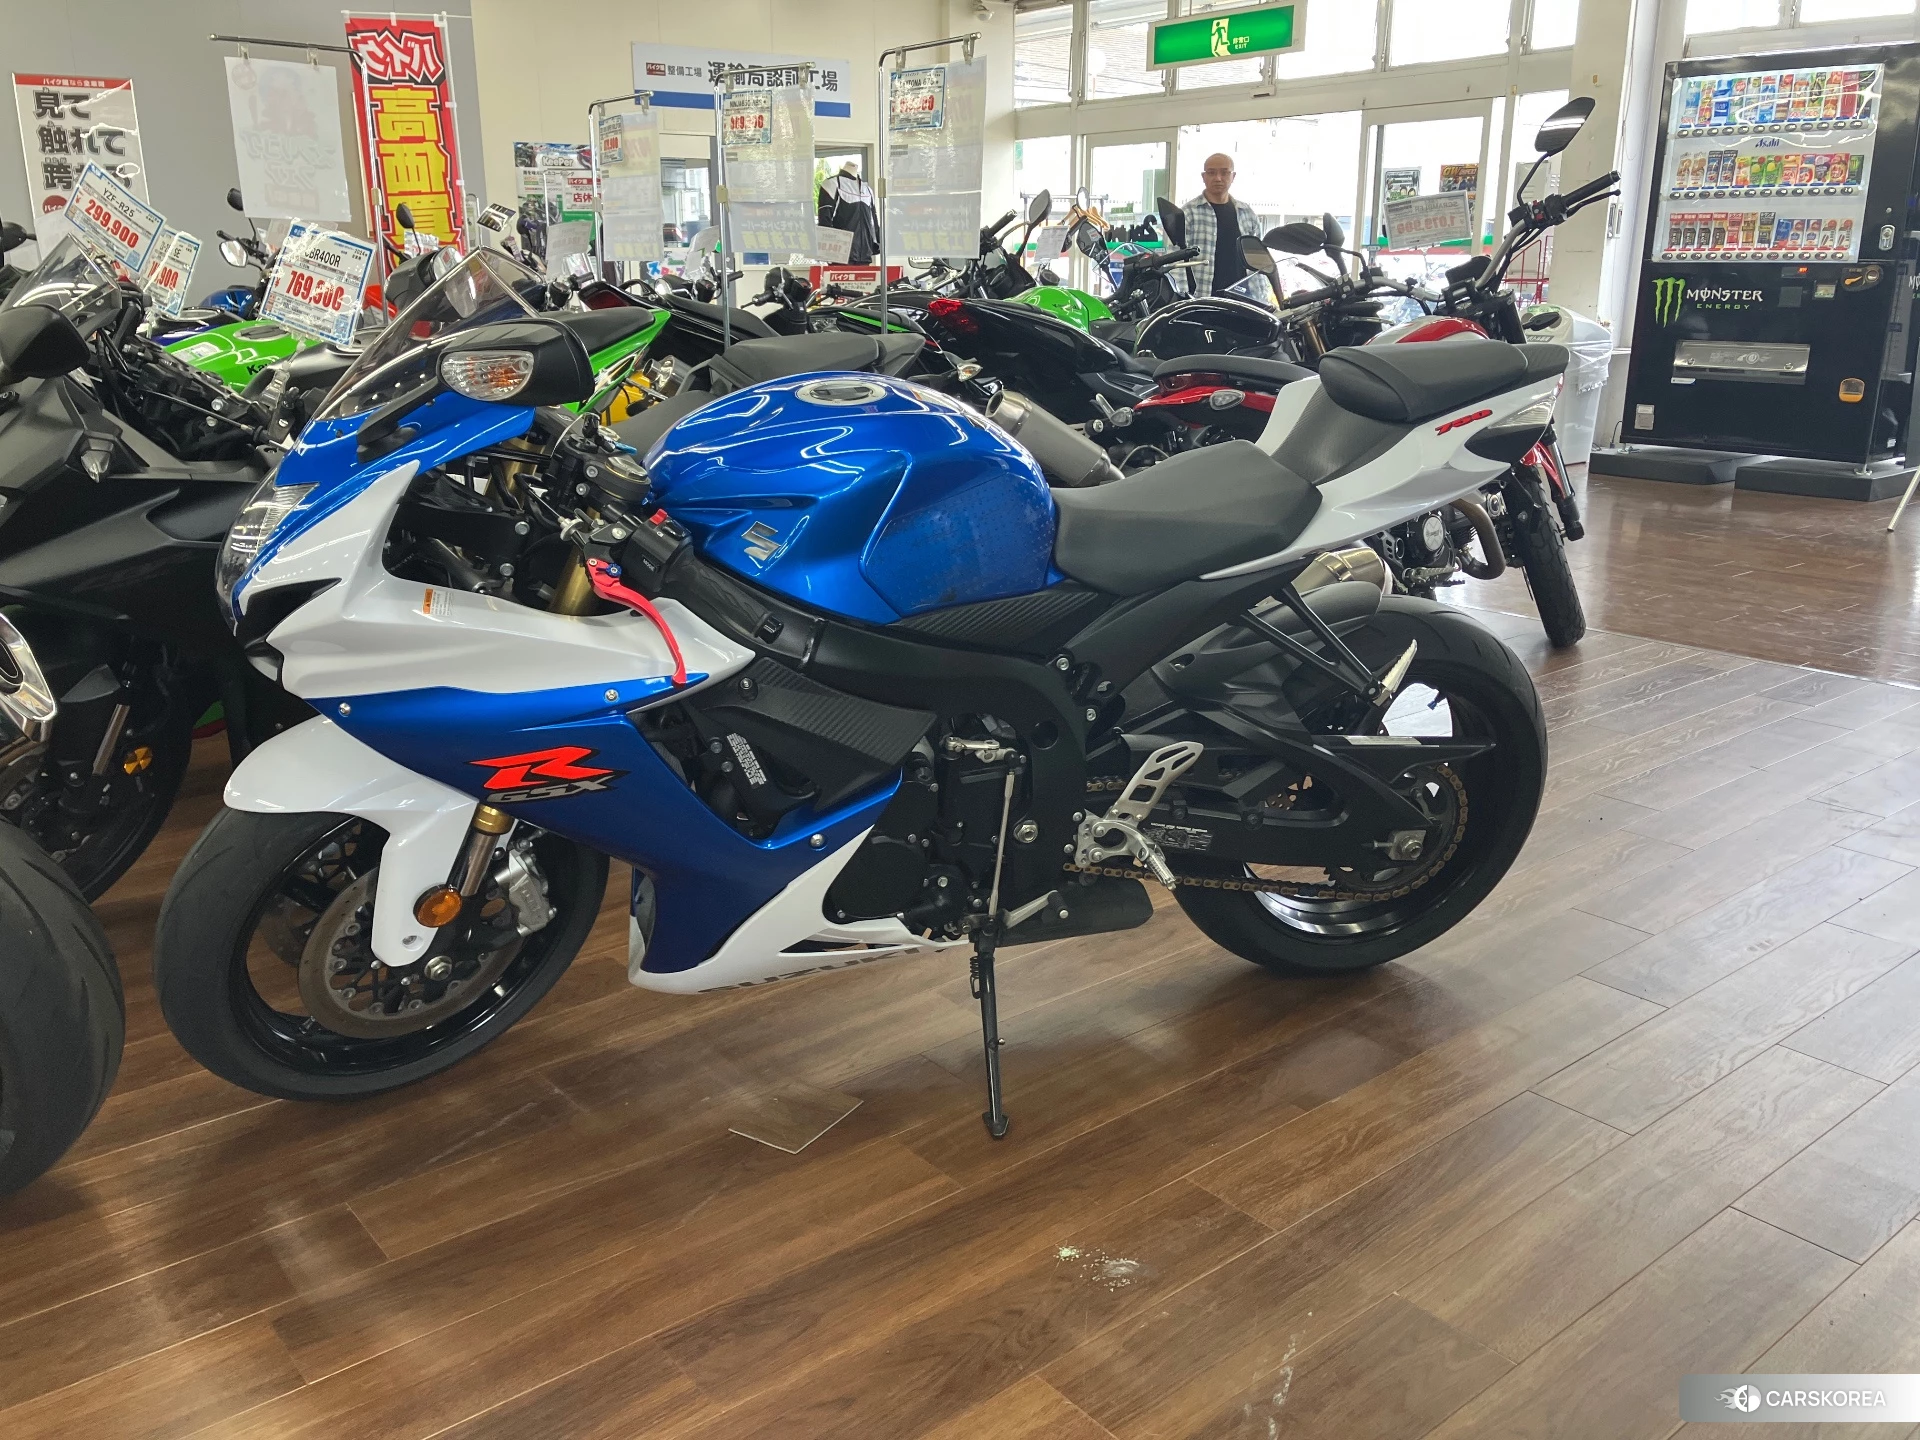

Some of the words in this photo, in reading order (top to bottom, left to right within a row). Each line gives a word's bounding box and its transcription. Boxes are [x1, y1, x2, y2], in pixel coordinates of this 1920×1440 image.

[1233, 36, 1249, 44] 非常口
[667, 65, 702, 77] 整備工場
[34, 90, 91, 120] 見て
[38, 125, 126, 156] 触れて
[1755, 138, 1780, 148] Asahi
[42, 161, 132, 190] 跨る
[541, 156, 574, 167] KeePer
[102, 187, 135, 218] YZF-R25
[84, 199, 139, 249] 299,900
[1686, 287, 1763, 302] MONSTER
[1434, 408, 1494, 436] 750
[465, 745, 630, 790] R
[486, 774, 618, 803] GSX
